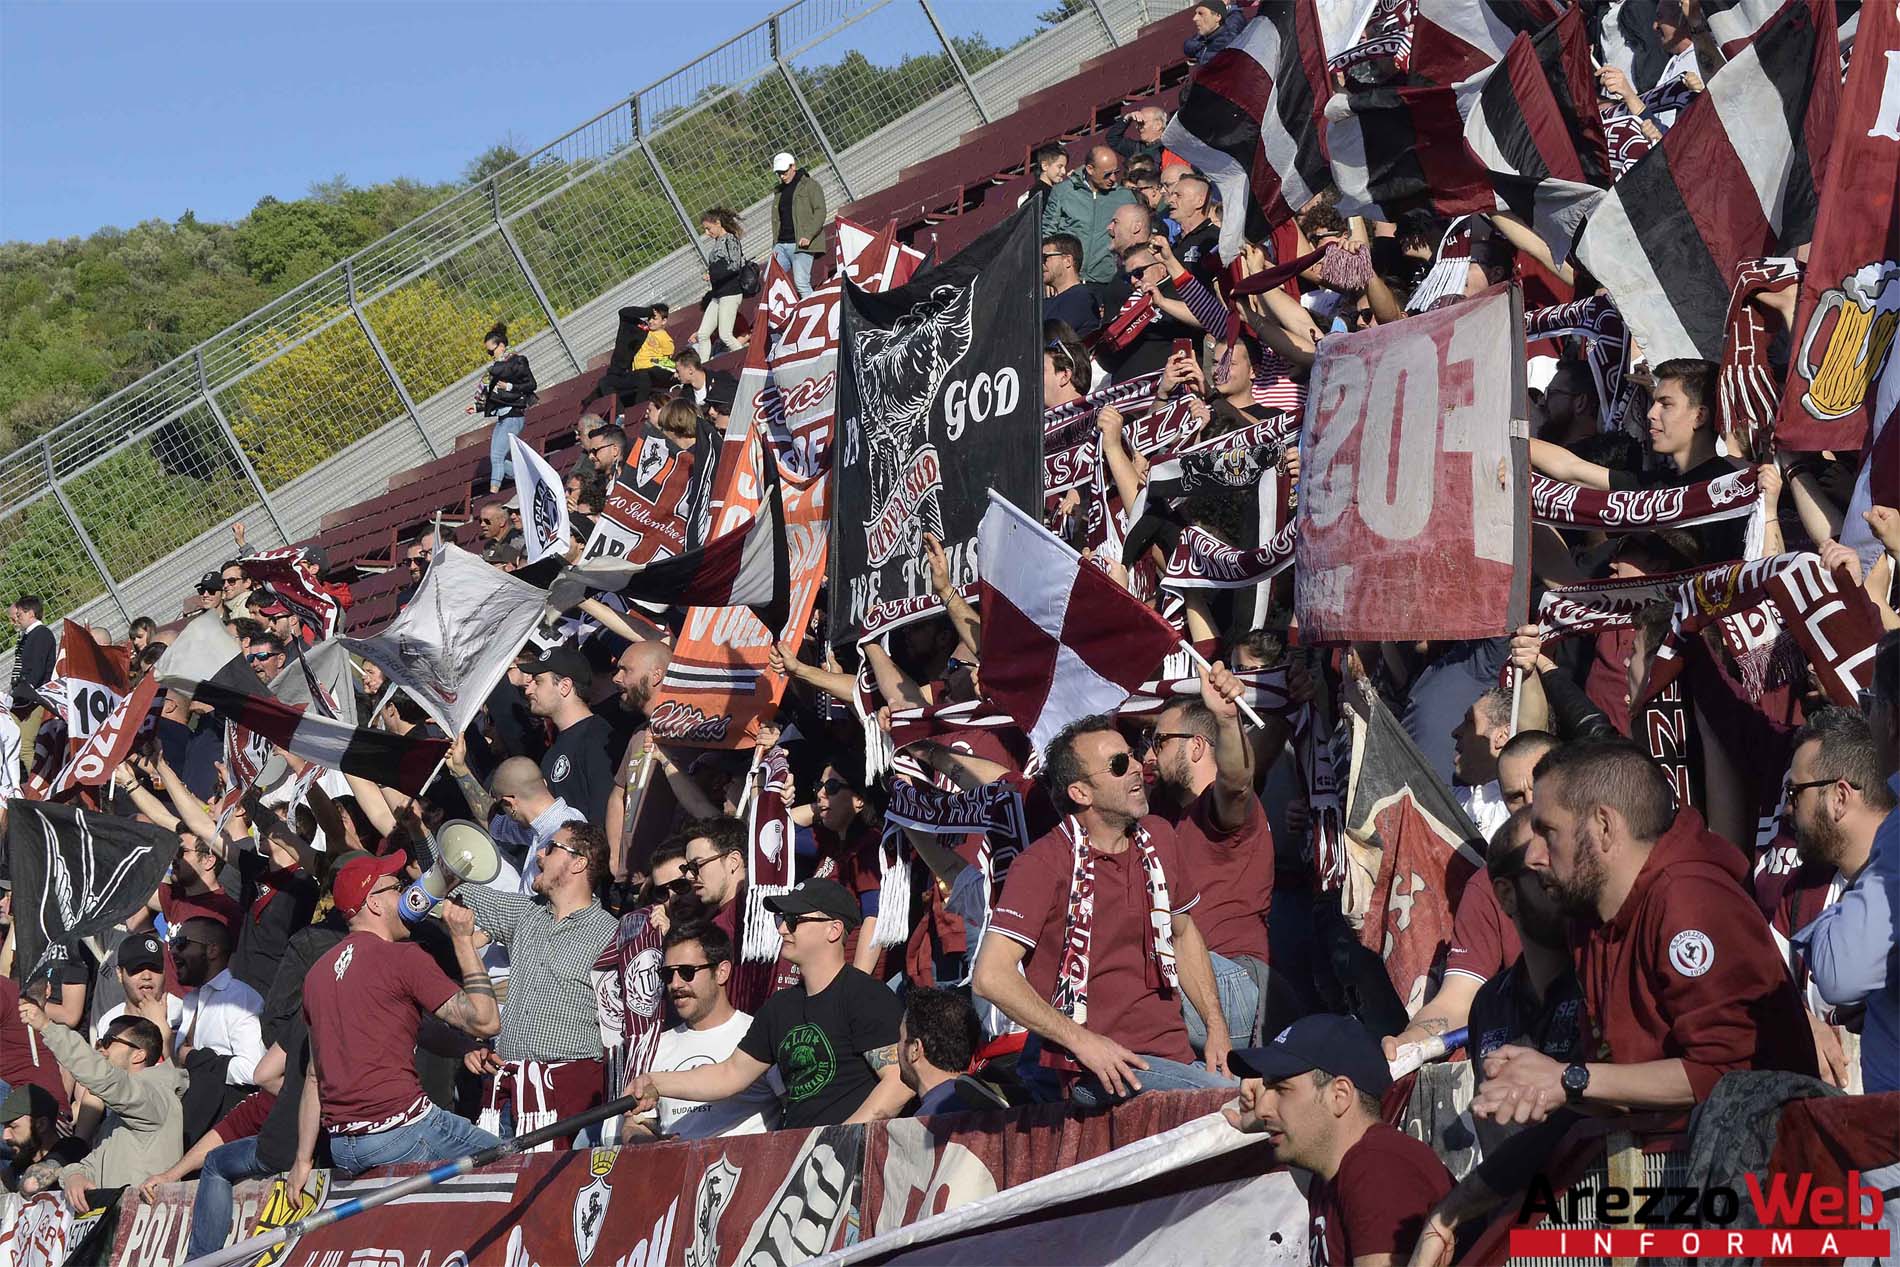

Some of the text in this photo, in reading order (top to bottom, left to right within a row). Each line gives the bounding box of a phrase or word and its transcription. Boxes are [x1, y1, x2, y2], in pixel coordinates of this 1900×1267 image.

[944, 366, 1021, 441] GOD
[625, 501, 682, 540] Settembre
[868, 496, 909, 560] CURVA
[905, 454, 938, 501] SUD
[1599, 486, 1690, 527] SUD
[1679, 930, 1706, 941] AREZZO
[671, 1104, 713, 1116] BUDAPEST
